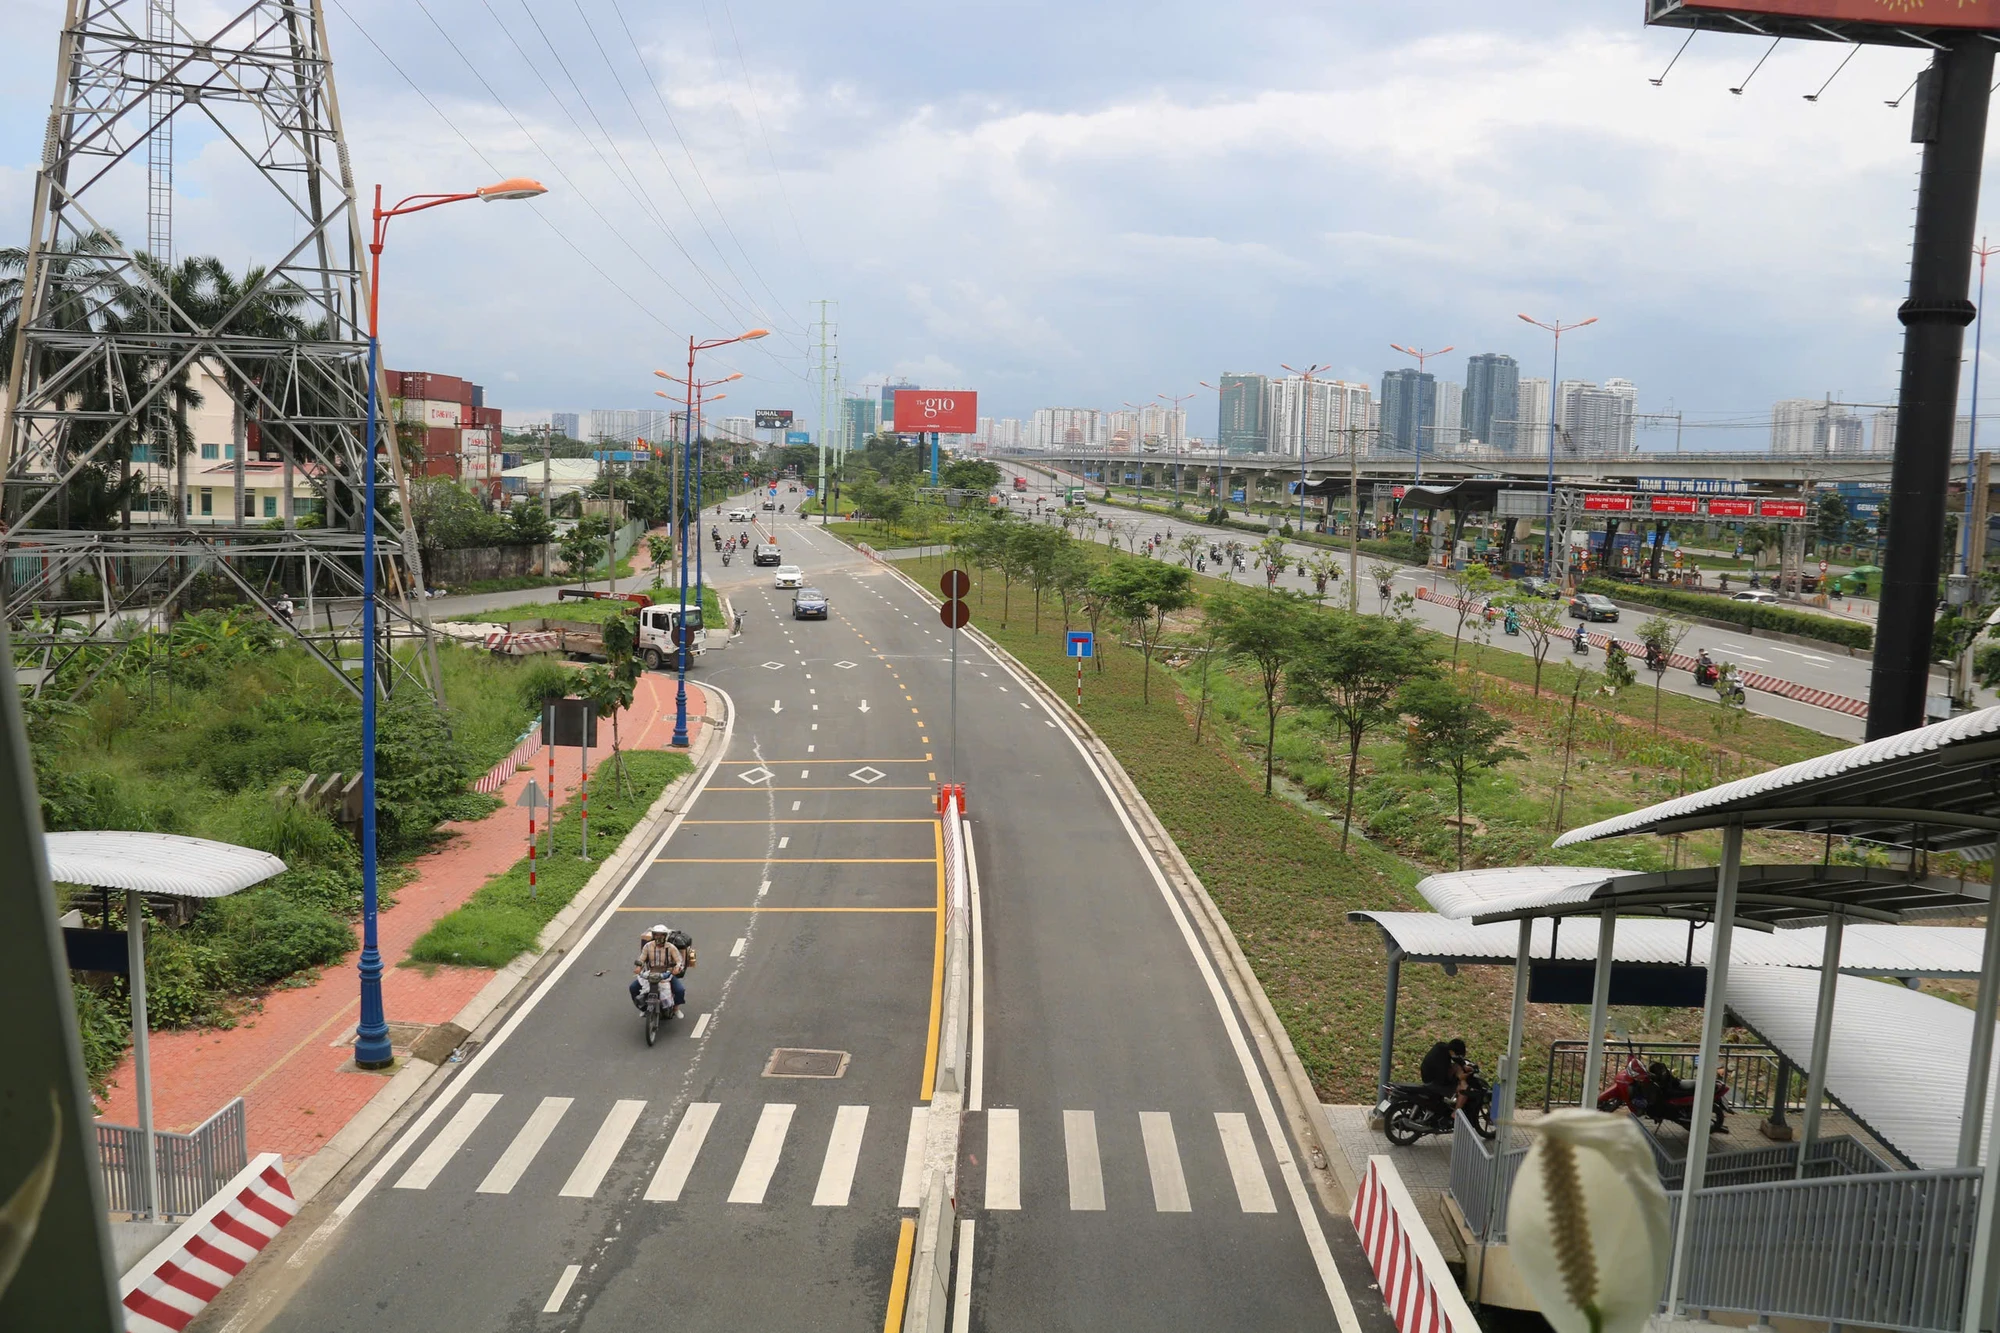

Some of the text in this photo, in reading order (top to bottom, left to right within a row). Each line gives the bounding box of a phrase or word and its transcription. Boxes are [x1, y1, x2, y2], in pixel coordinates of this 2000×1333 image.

[1639, 479, 1661, 491] TRẠM
[1664, 480, 1679, 490] THU
[1681, 479, 1694, 491] PHÍ
[1696, 481, 1707, 492] XA
